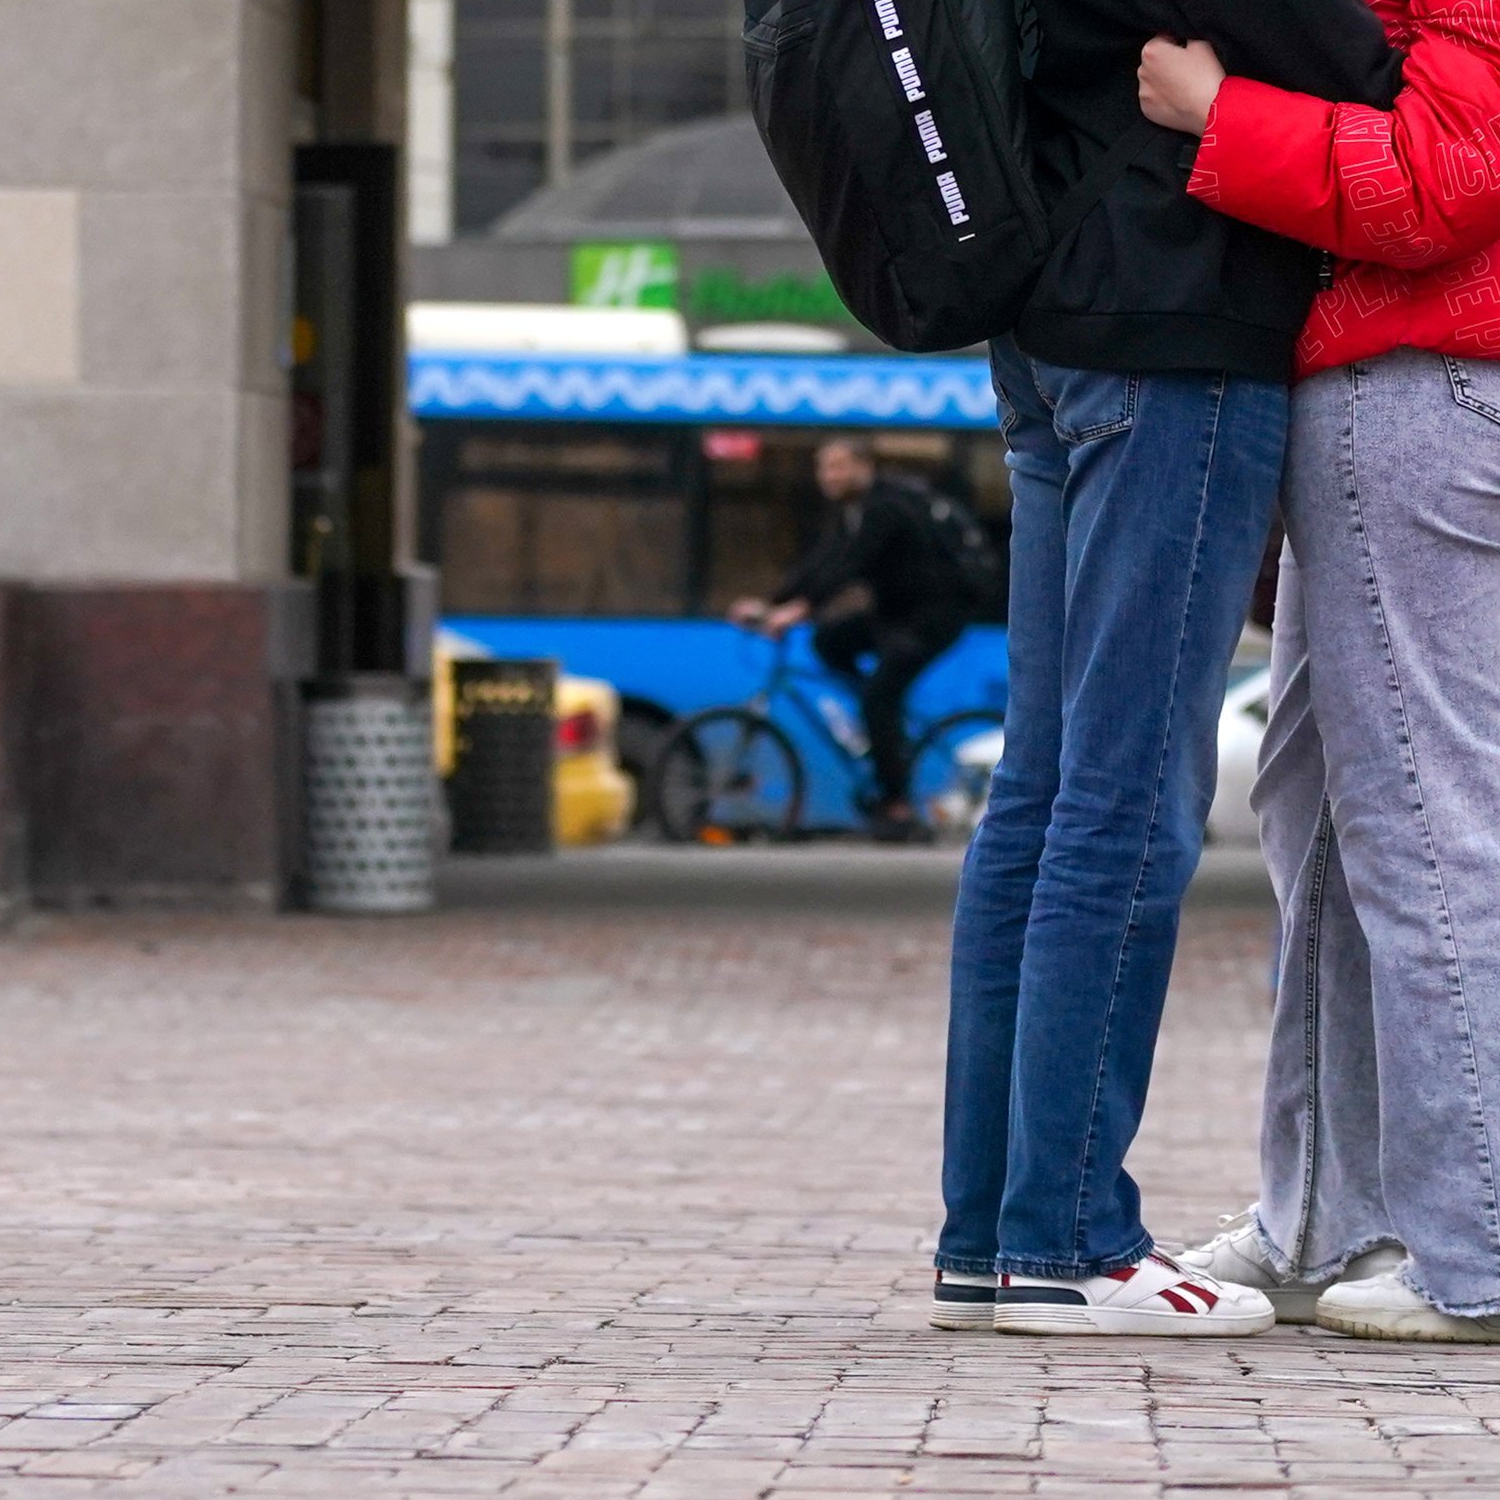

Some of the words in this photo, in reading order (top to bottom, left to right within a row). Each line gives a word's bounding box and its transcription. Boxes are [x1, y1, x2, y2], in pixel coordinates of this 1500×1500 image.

[891, 47, 926, 103] PUMA
[914, 109, 948, 164] PUMA
[936, 171, 970, 225] PUMA
[1316, 265, 1411, 338] PLA
